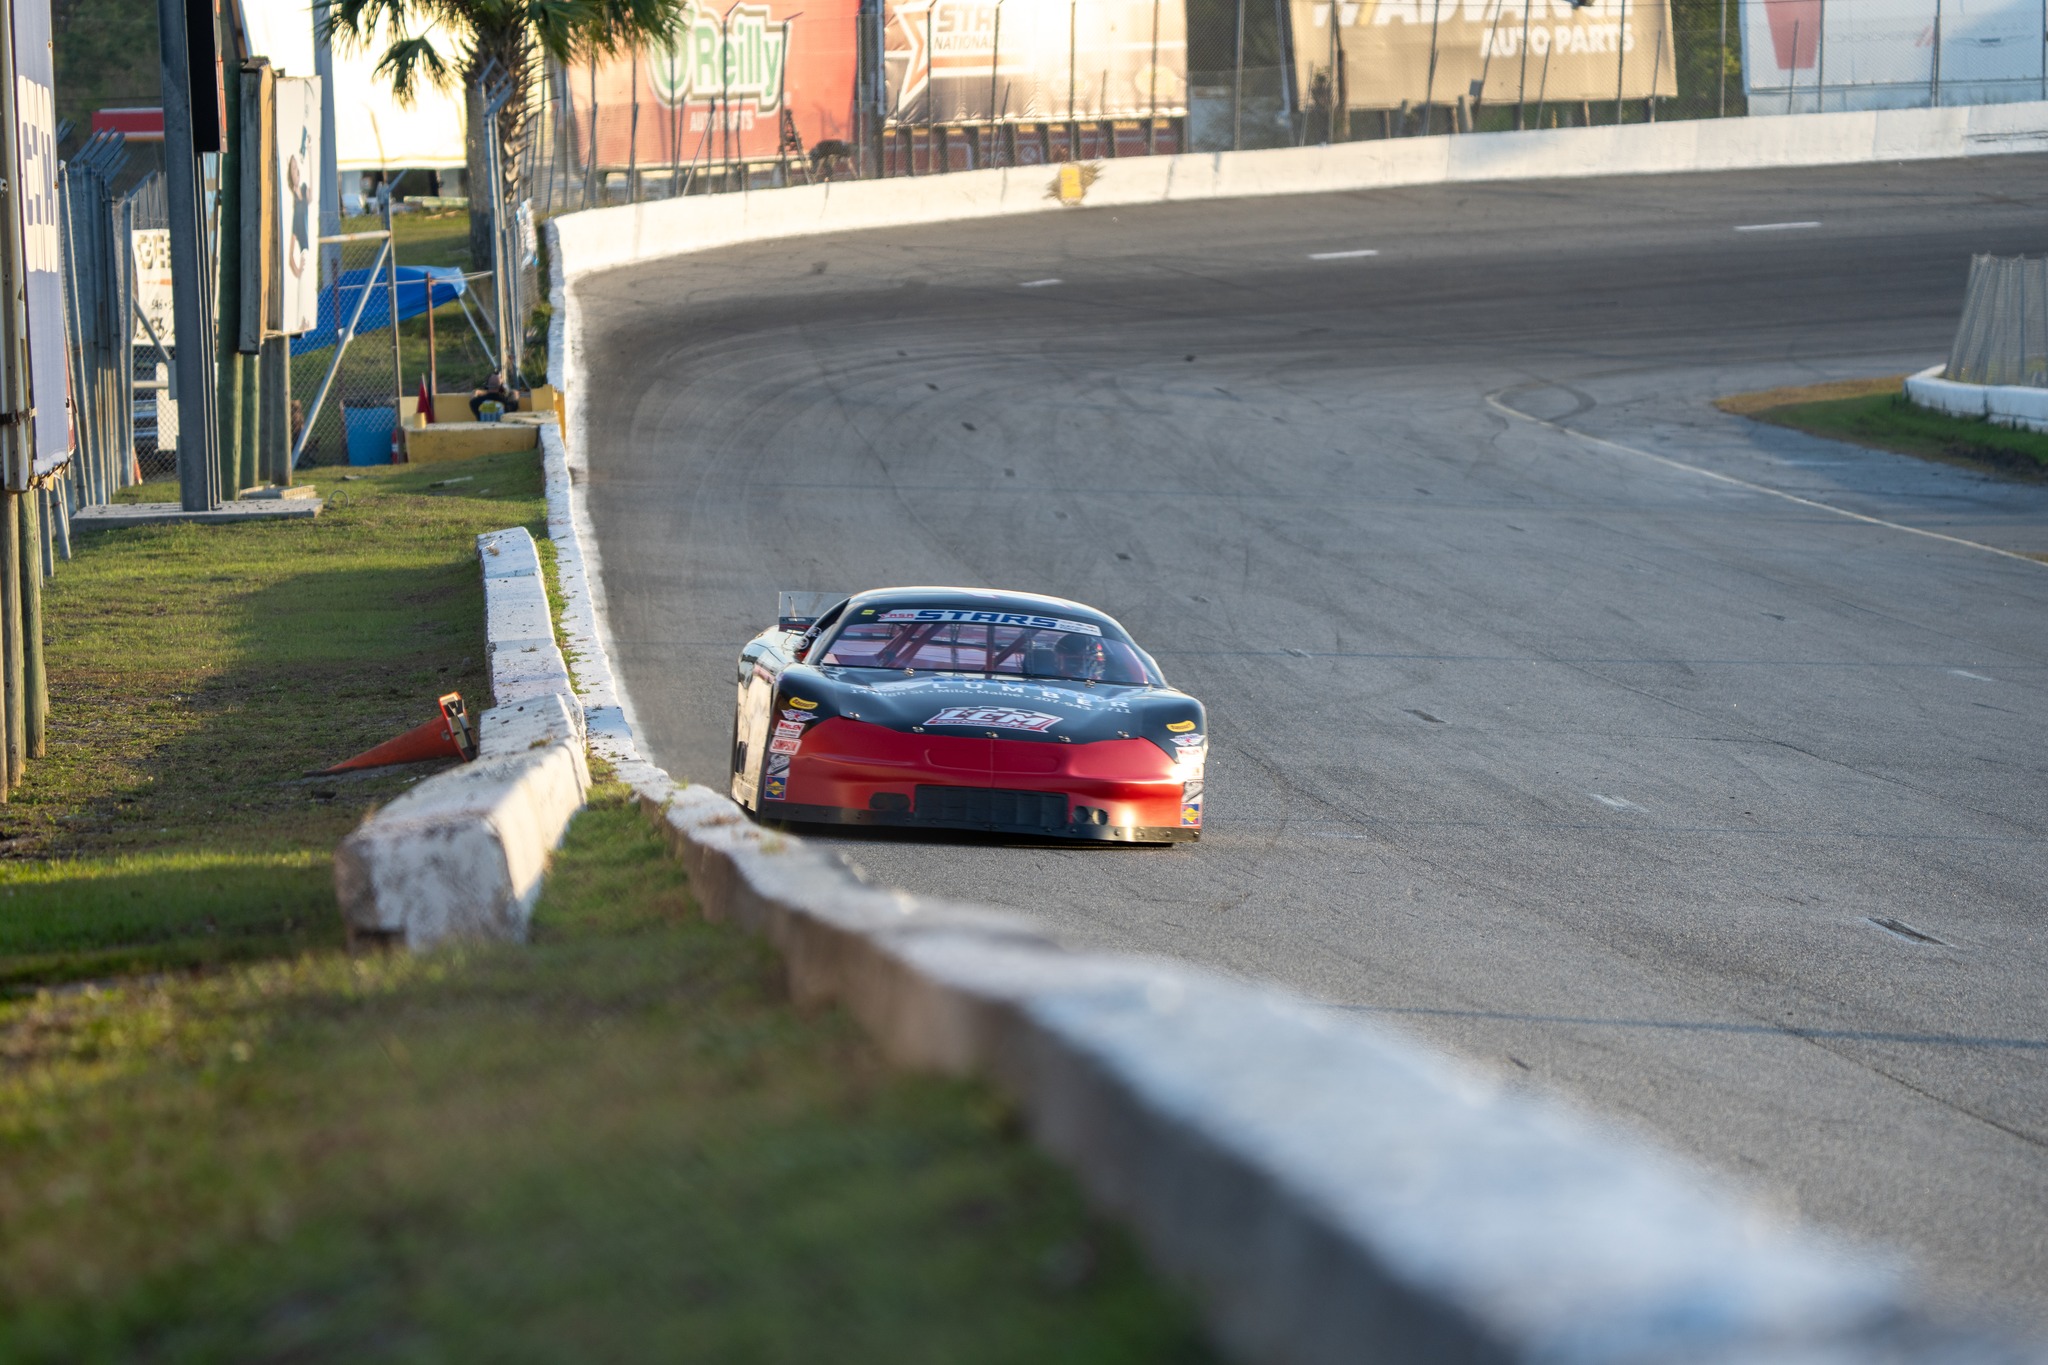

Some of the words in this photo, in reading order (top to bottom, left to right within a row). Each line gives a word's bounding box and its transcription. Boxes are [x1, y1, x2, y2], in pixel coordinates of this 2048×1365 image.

[1480, 25, 1551, 58] AUTO
[1555, 23, 1635, 54] PARTS
[915, 610, 1060, 628] STARS
[976, 689, 1022, 698] Maine
